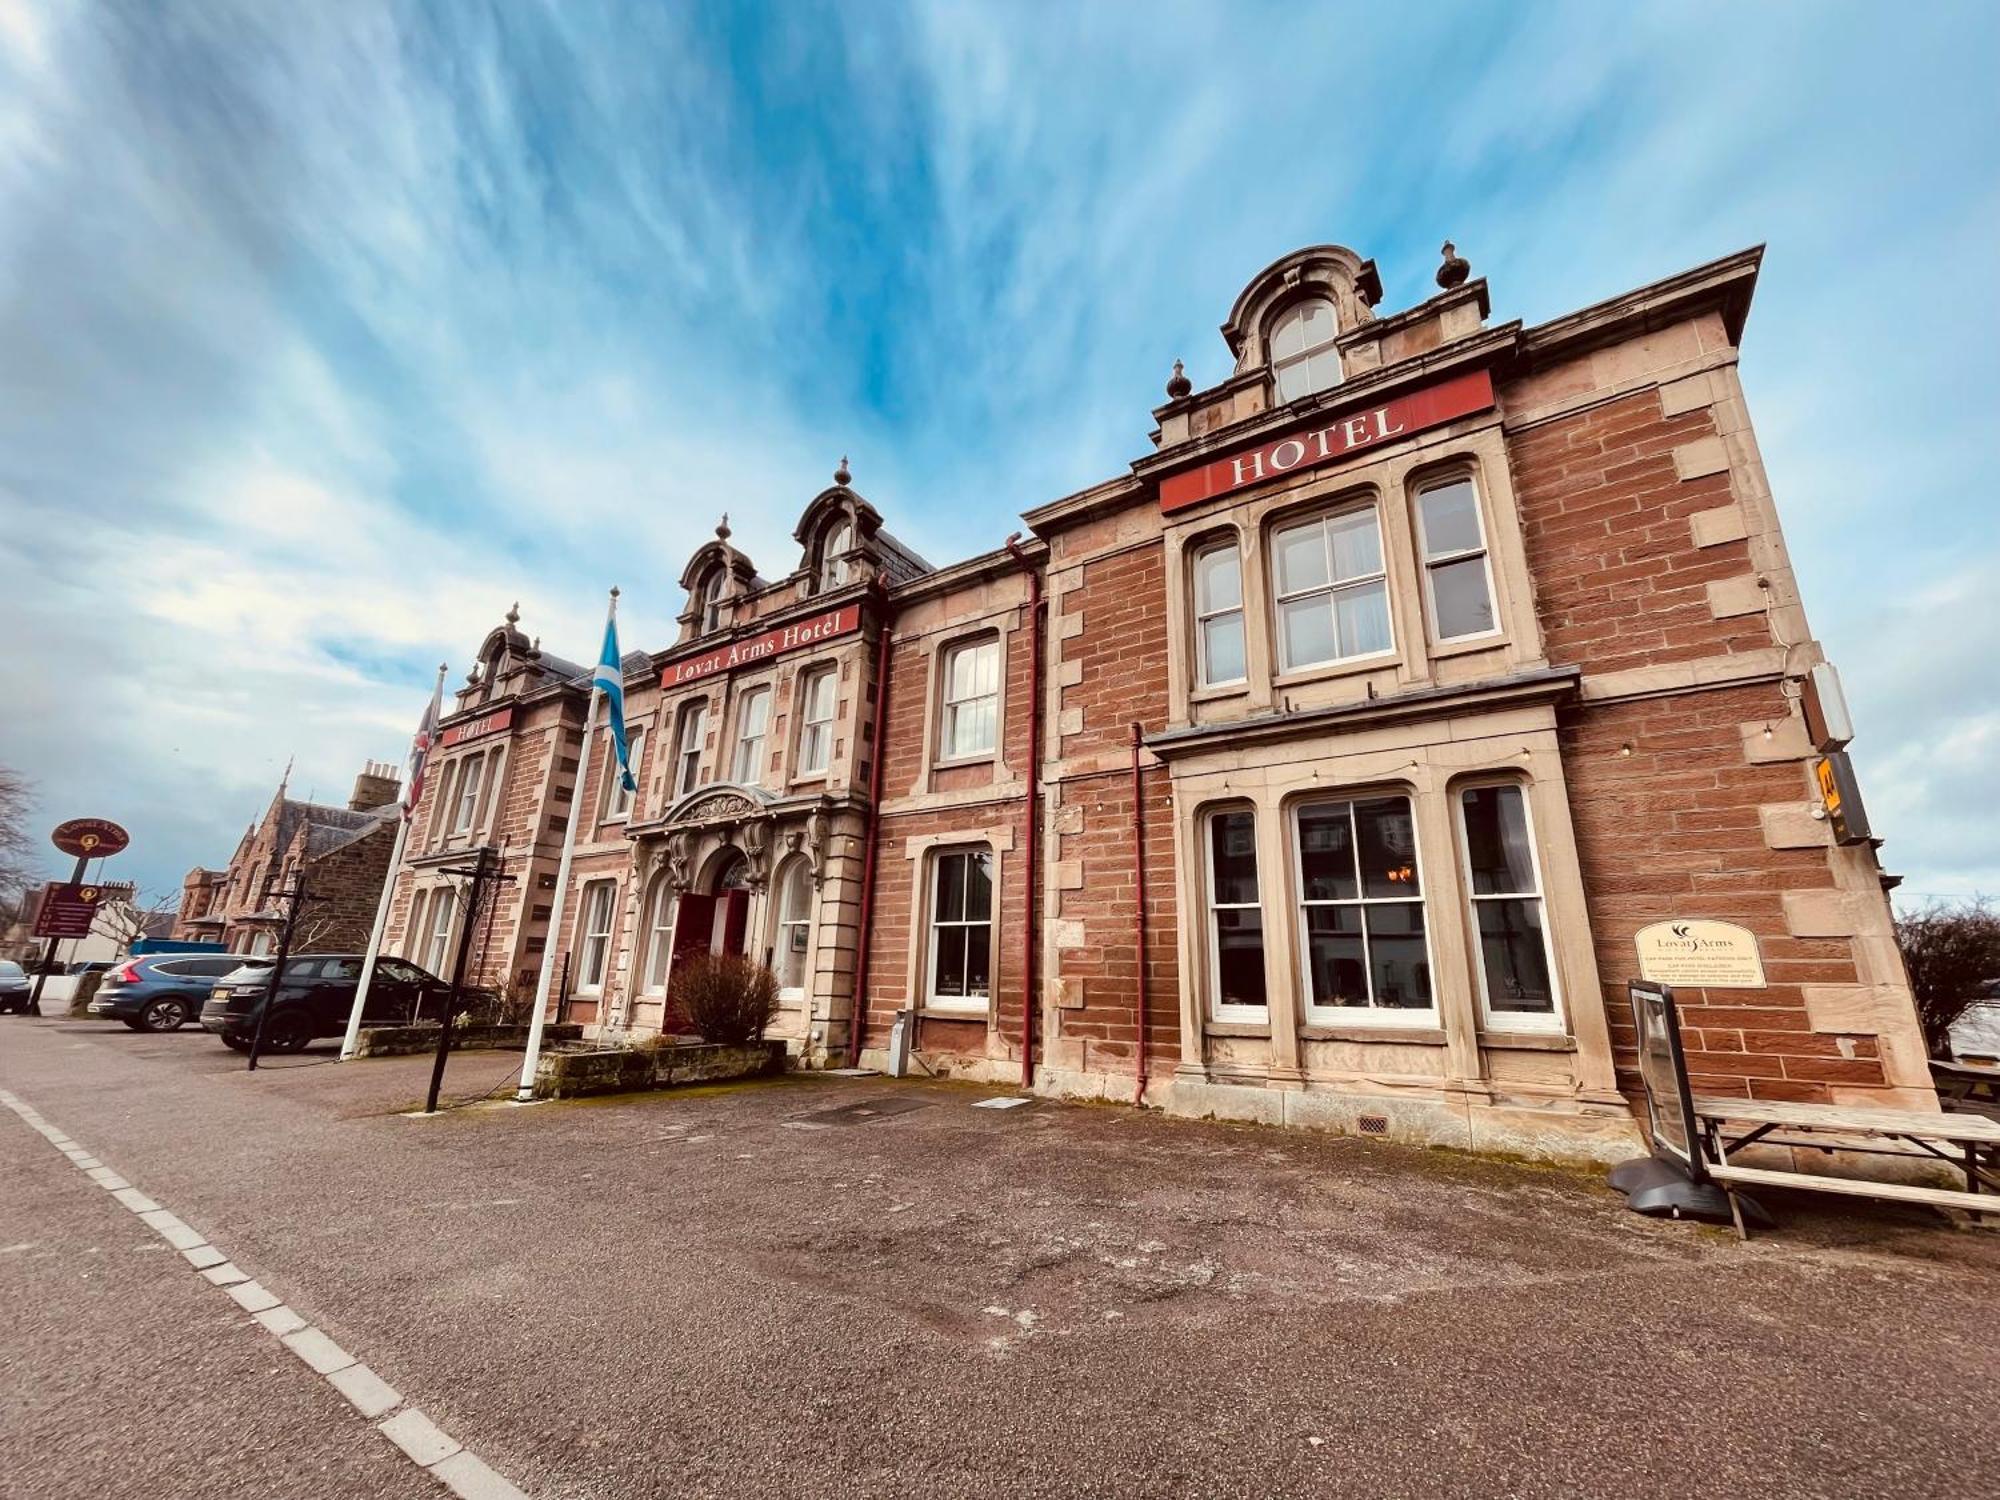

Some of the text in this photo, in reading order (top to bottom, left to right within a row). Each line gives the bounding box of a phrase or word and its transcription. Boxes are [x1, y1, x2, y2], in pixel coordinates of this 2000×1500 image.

[1231, 408, 1404, 486] HOTEL
[675, 612, 841, 682] Lovat Arms Hotel
[457, 718, 492, 741] HOTEL
[1657, 939, 1698, 951] Lovat
[1700, 939, 1734, 948] Arms
